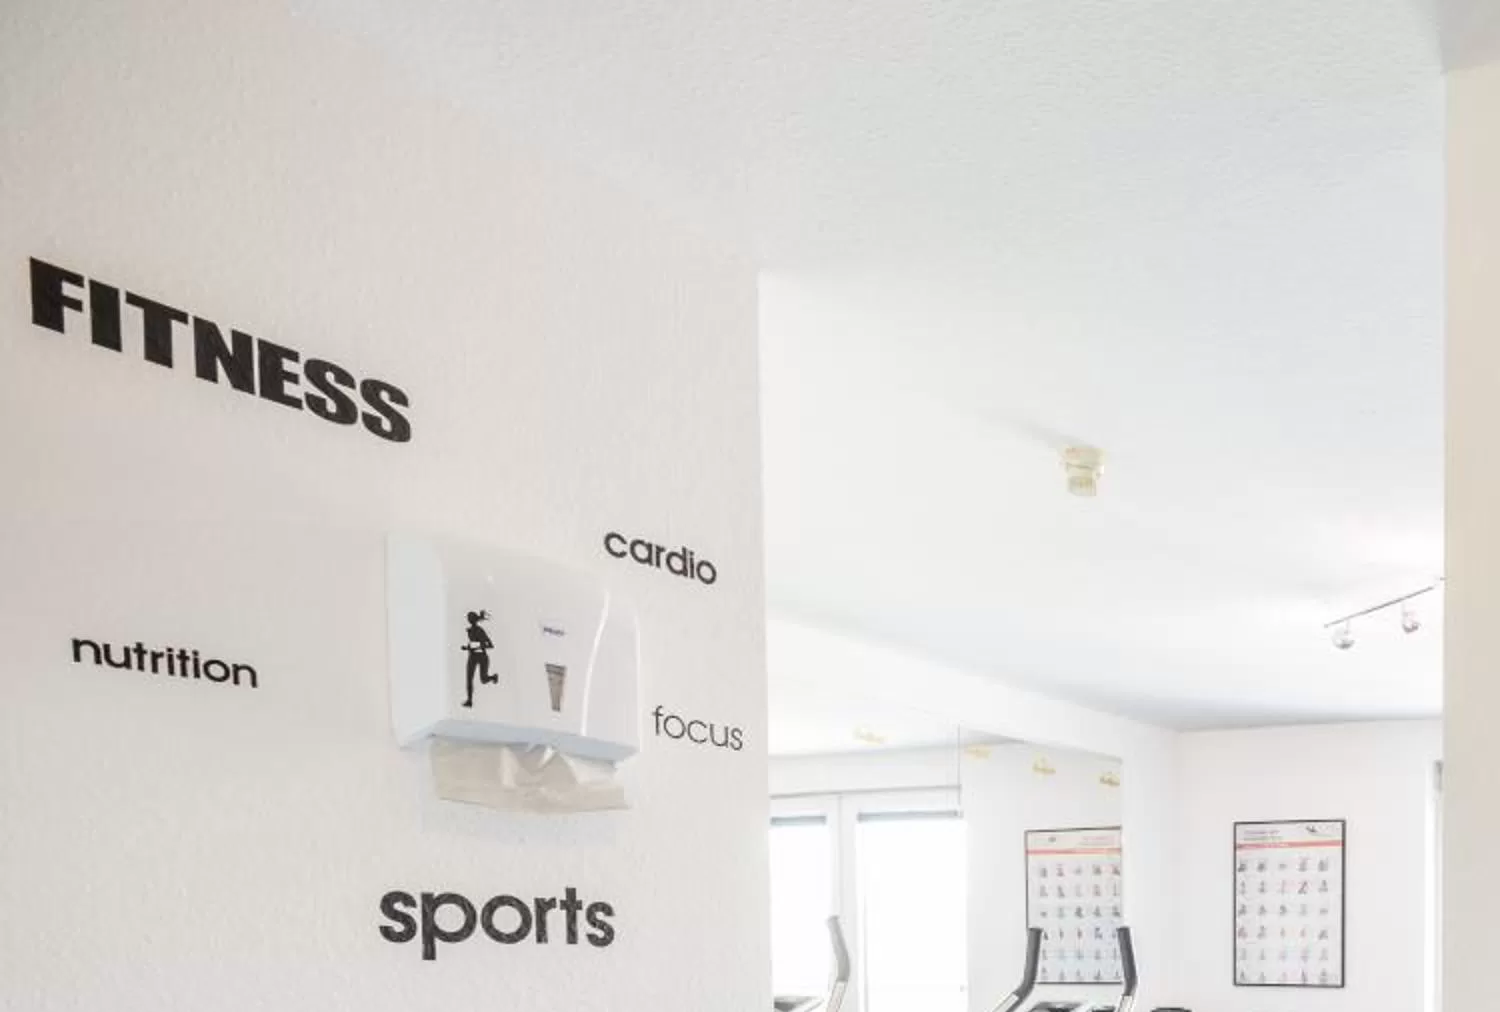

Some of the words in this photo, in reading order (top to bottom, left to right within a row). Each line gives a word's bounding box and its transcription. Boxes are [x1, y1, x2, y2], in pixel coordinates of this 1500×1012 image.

[29, 256, 412, 443] FITNESS
[604, 532, 717, 585] cardio
[72, 637, 258, 689] nutrition
[653, 705, 743, 751] focus
[379, 887, 615, 961] sports
